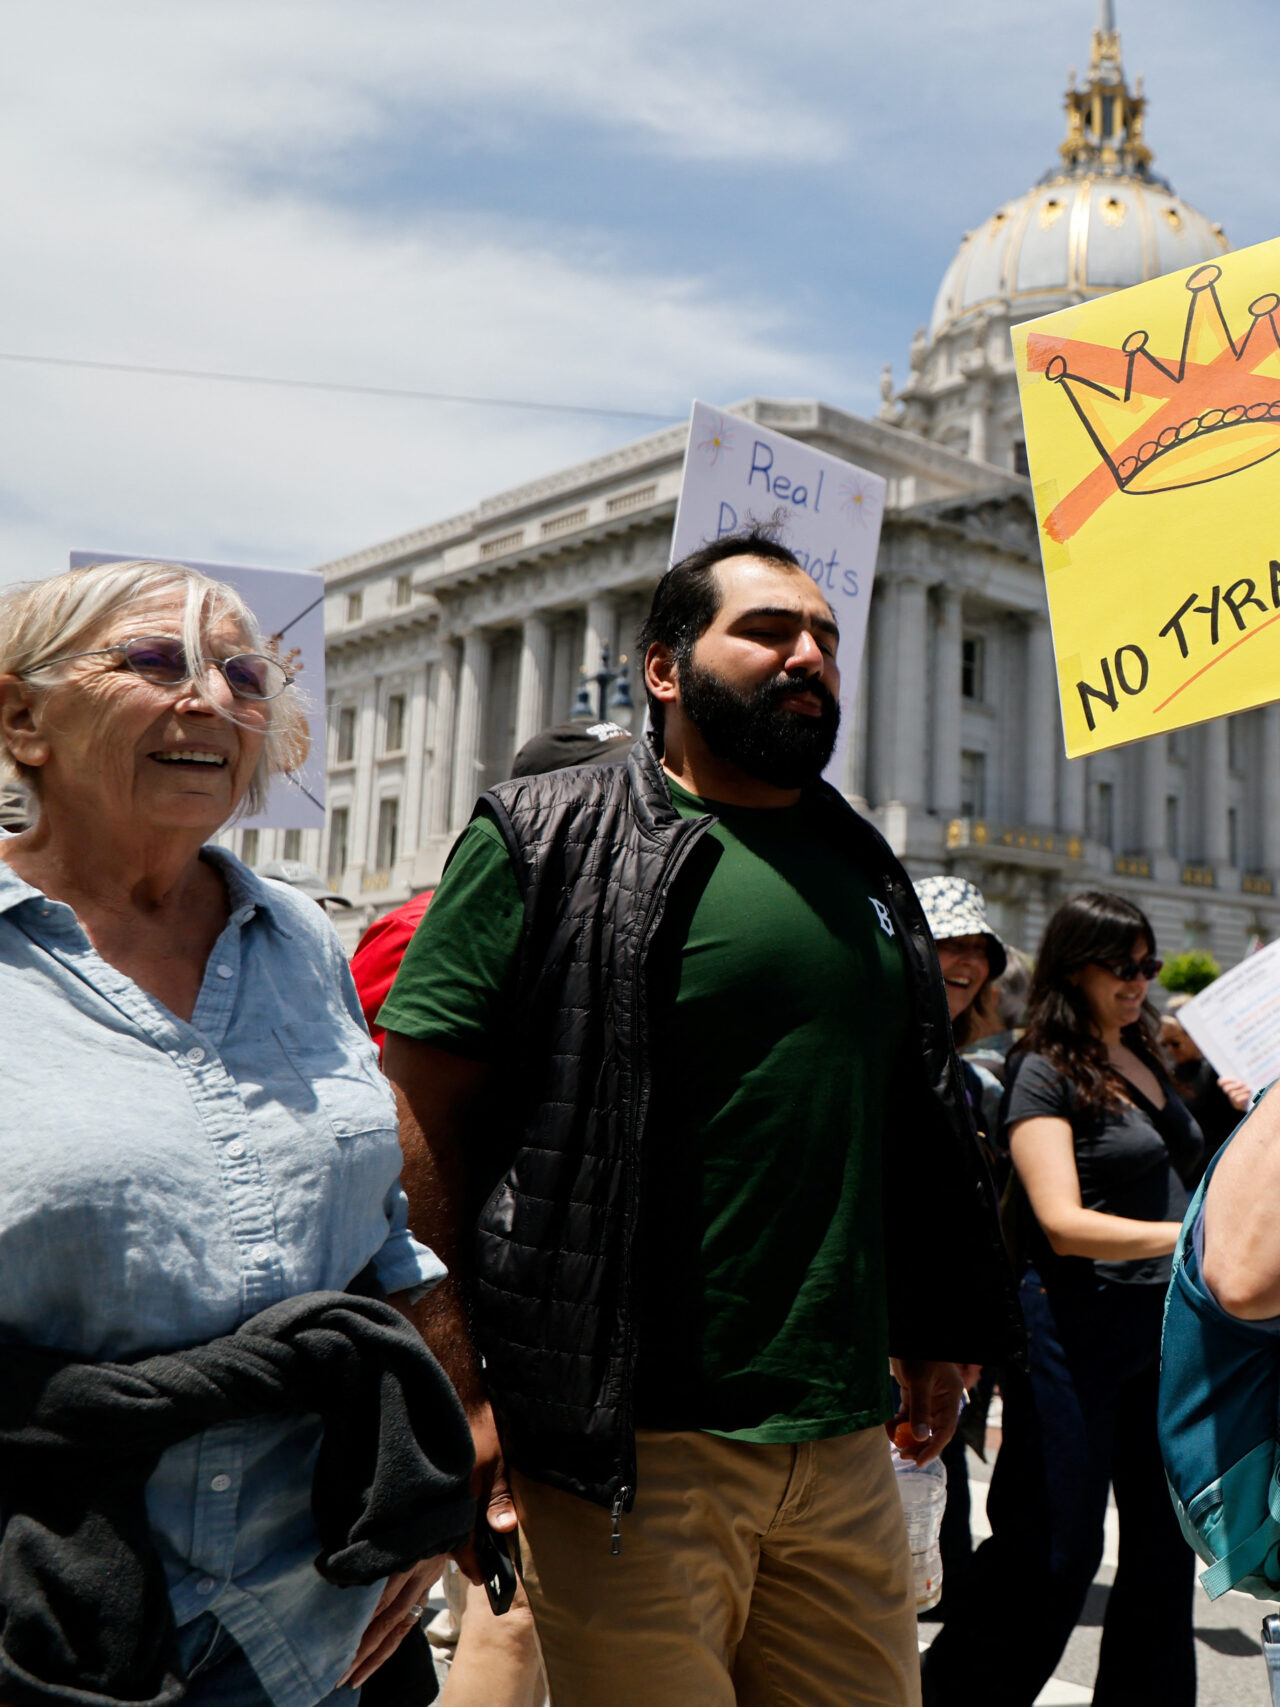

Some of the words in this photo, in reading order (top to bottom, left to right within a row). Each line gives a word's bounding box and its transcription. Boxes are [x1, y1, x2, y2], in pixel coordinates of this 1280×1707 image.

[748, 440, 825, 513] Real
[1076, 644, 1149, 732] NO
[868, 896, 896, 938] B
